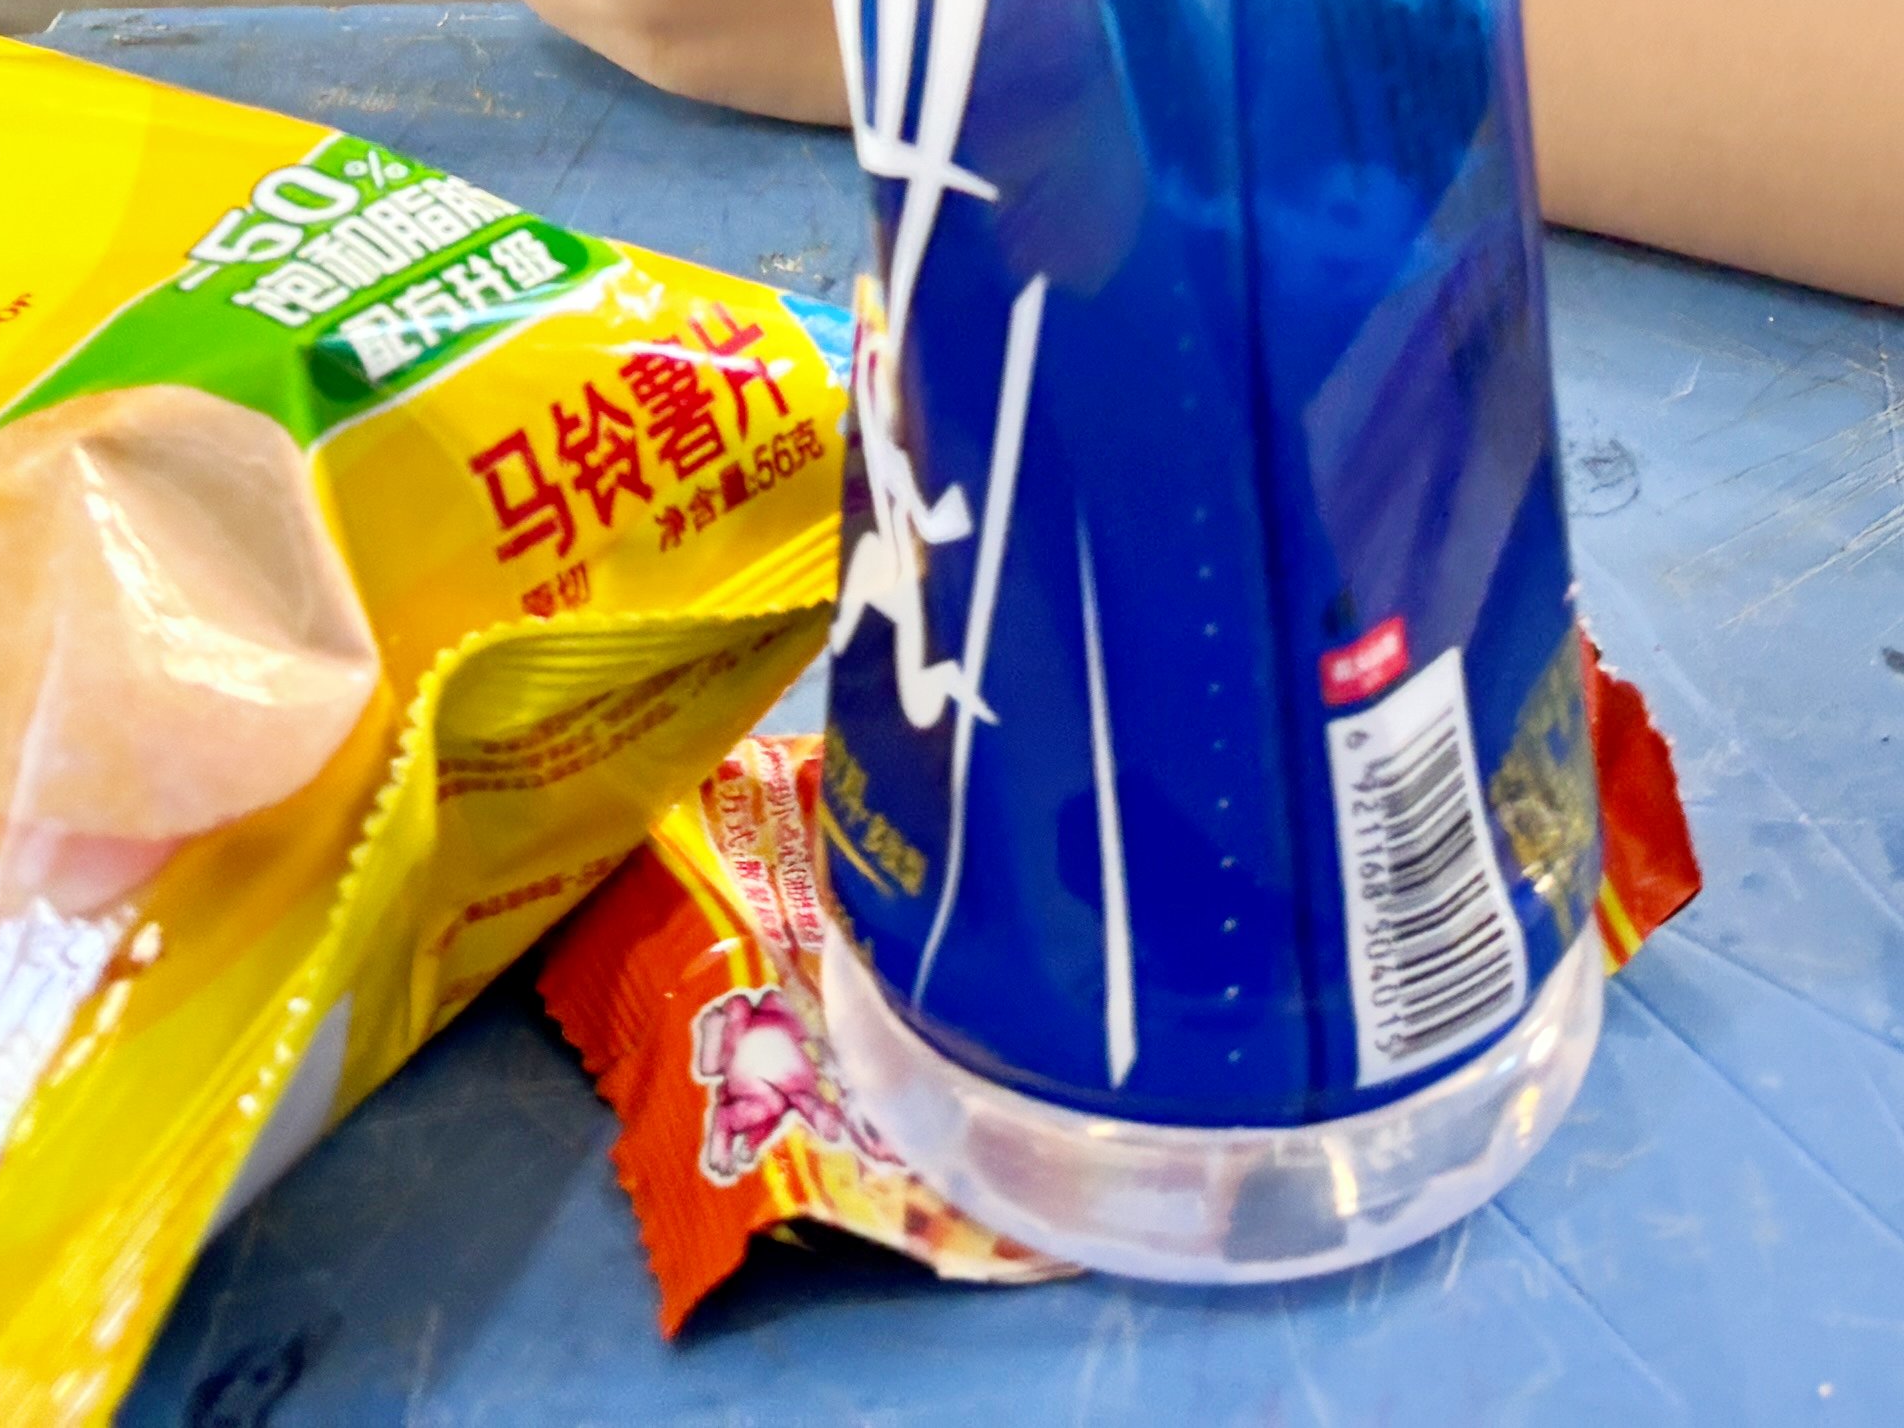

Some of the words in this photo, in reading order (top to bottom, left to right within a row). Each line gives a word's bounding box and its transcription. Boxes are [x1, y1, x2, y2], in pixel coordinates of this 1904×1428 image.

[339, 228, 567, 384] 配方升级
[470, 301, 791, 564] 马铃薯片
